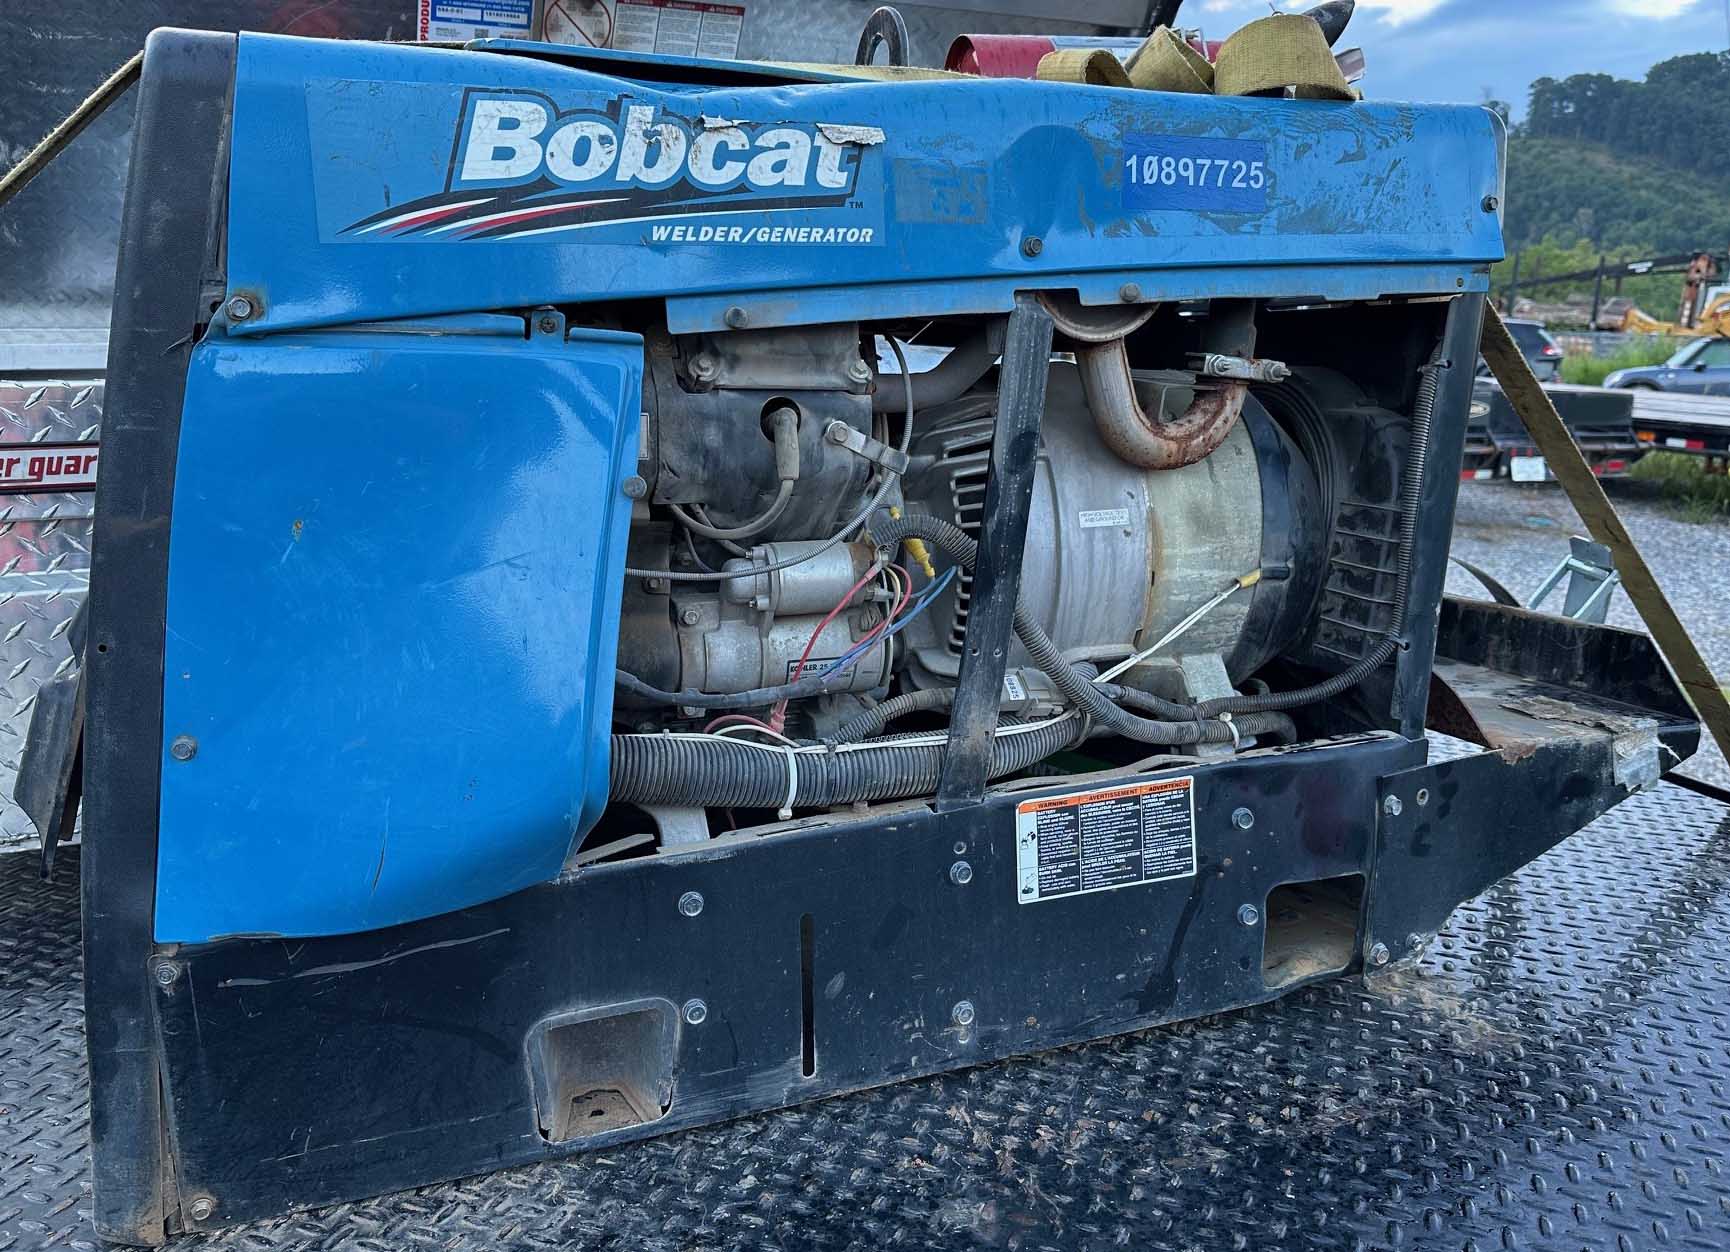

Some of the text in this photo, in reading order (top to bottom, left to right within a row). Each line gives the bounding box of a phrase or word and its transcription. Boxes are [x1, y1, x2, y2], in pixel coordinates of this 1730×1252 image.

[460, 98, 854, 189] Bobcat
[650, 225, 873, 245] WELDER/GENERATOR
[1149, 781, 1188, 792] ADVERTENCIA
[1089, 789, 1137, 801] AVERTISSEMENT
[1038, 800, 1068, 809] WARNING
